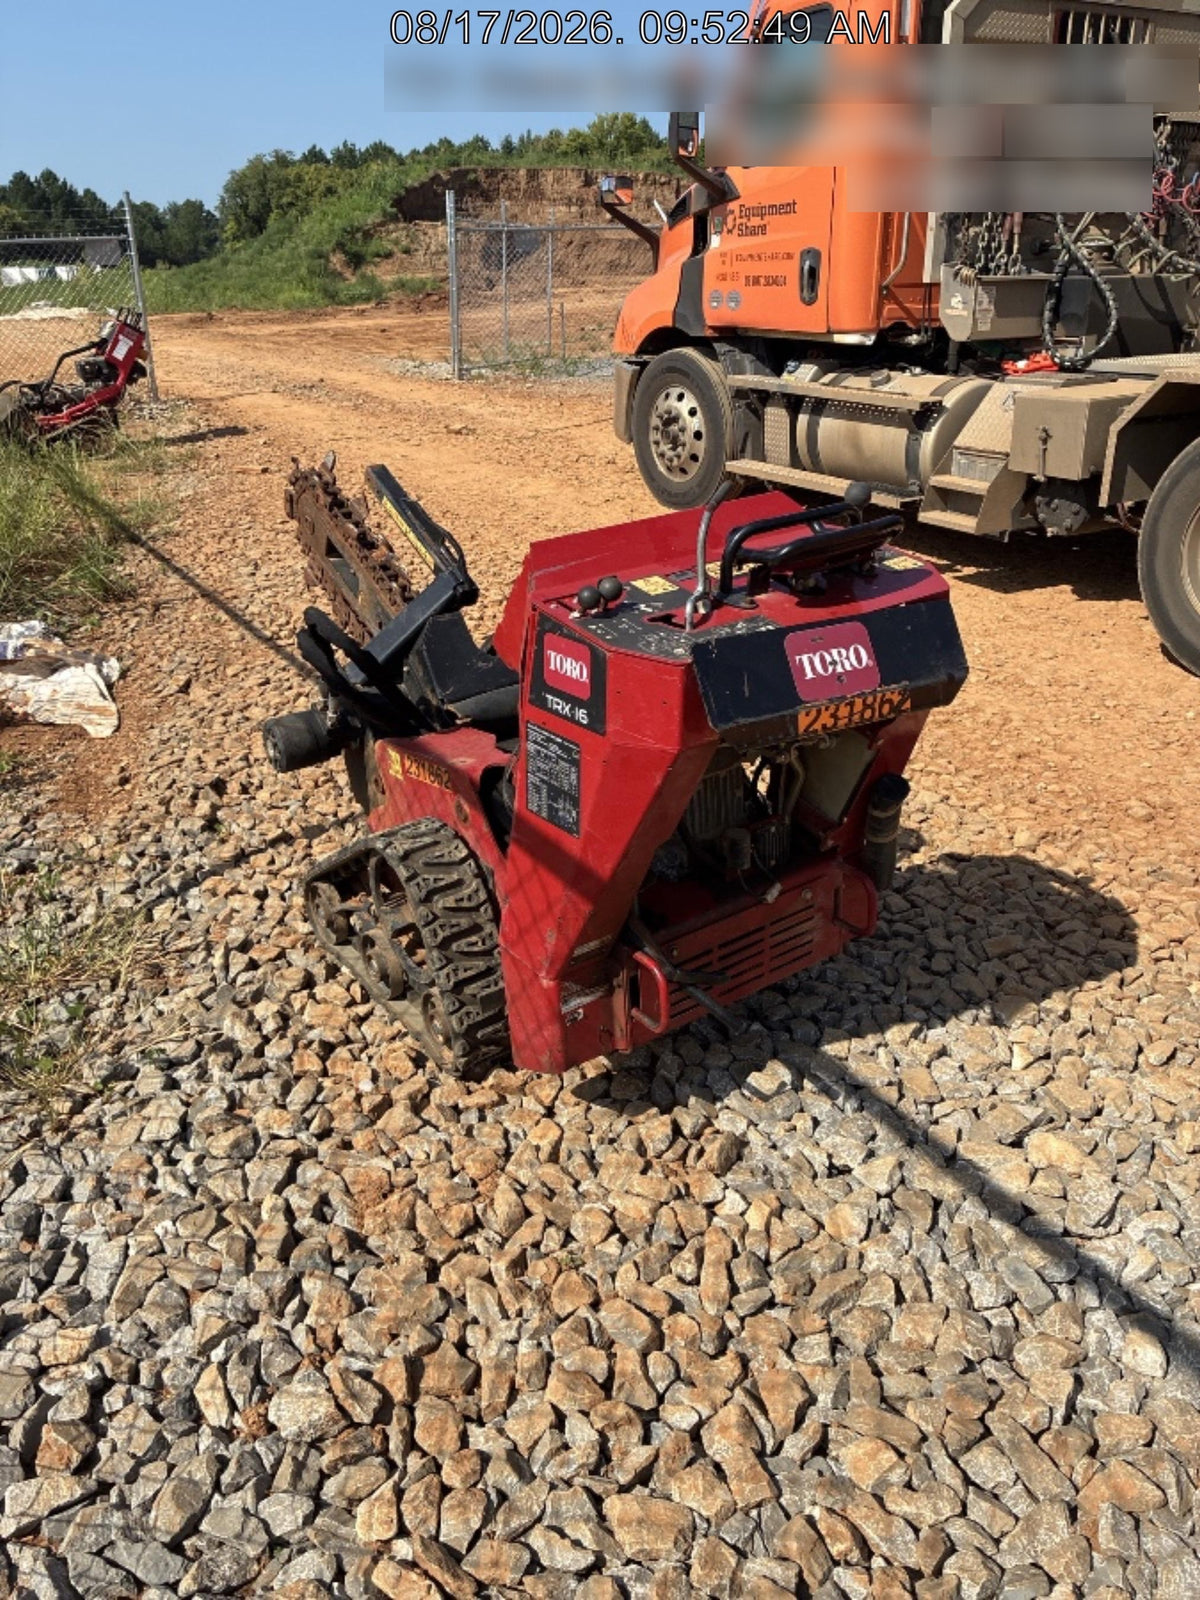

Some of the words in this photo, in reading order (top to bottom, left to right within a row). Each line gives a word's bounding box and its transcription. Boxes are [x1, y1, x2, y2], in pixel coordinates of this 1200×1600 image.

[739, 199, 797, 222] Equipment
[737, 222, 767, 237] Share
[547, 650, 589, 683] TORO
[795, 643, 869, 681] TORO
[545, 694, 589, 725] TRX-16
